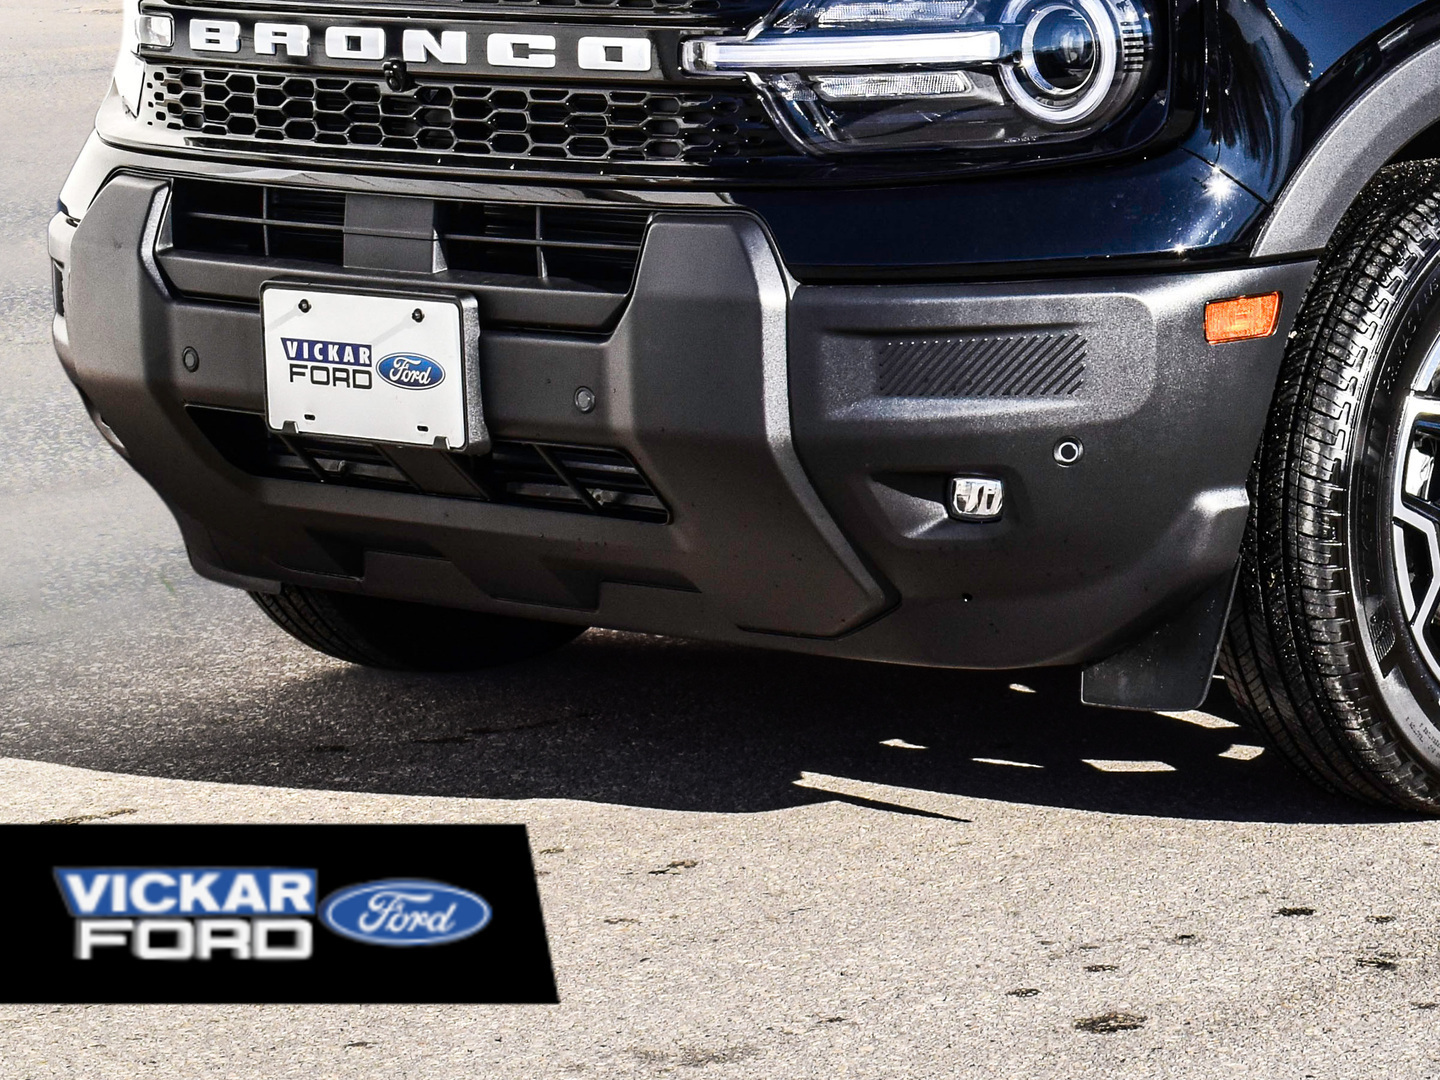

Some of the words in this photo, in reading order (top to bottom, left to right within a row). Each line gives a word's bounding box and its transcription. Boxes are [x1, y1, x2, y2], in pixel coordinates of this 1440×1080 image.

[189, 18, 651, 71] BRONCO
[286, 341, 371, 365] VICKAR
[289, 363, 372, 389] FORD
[389, 357, 432, 385] Ford
